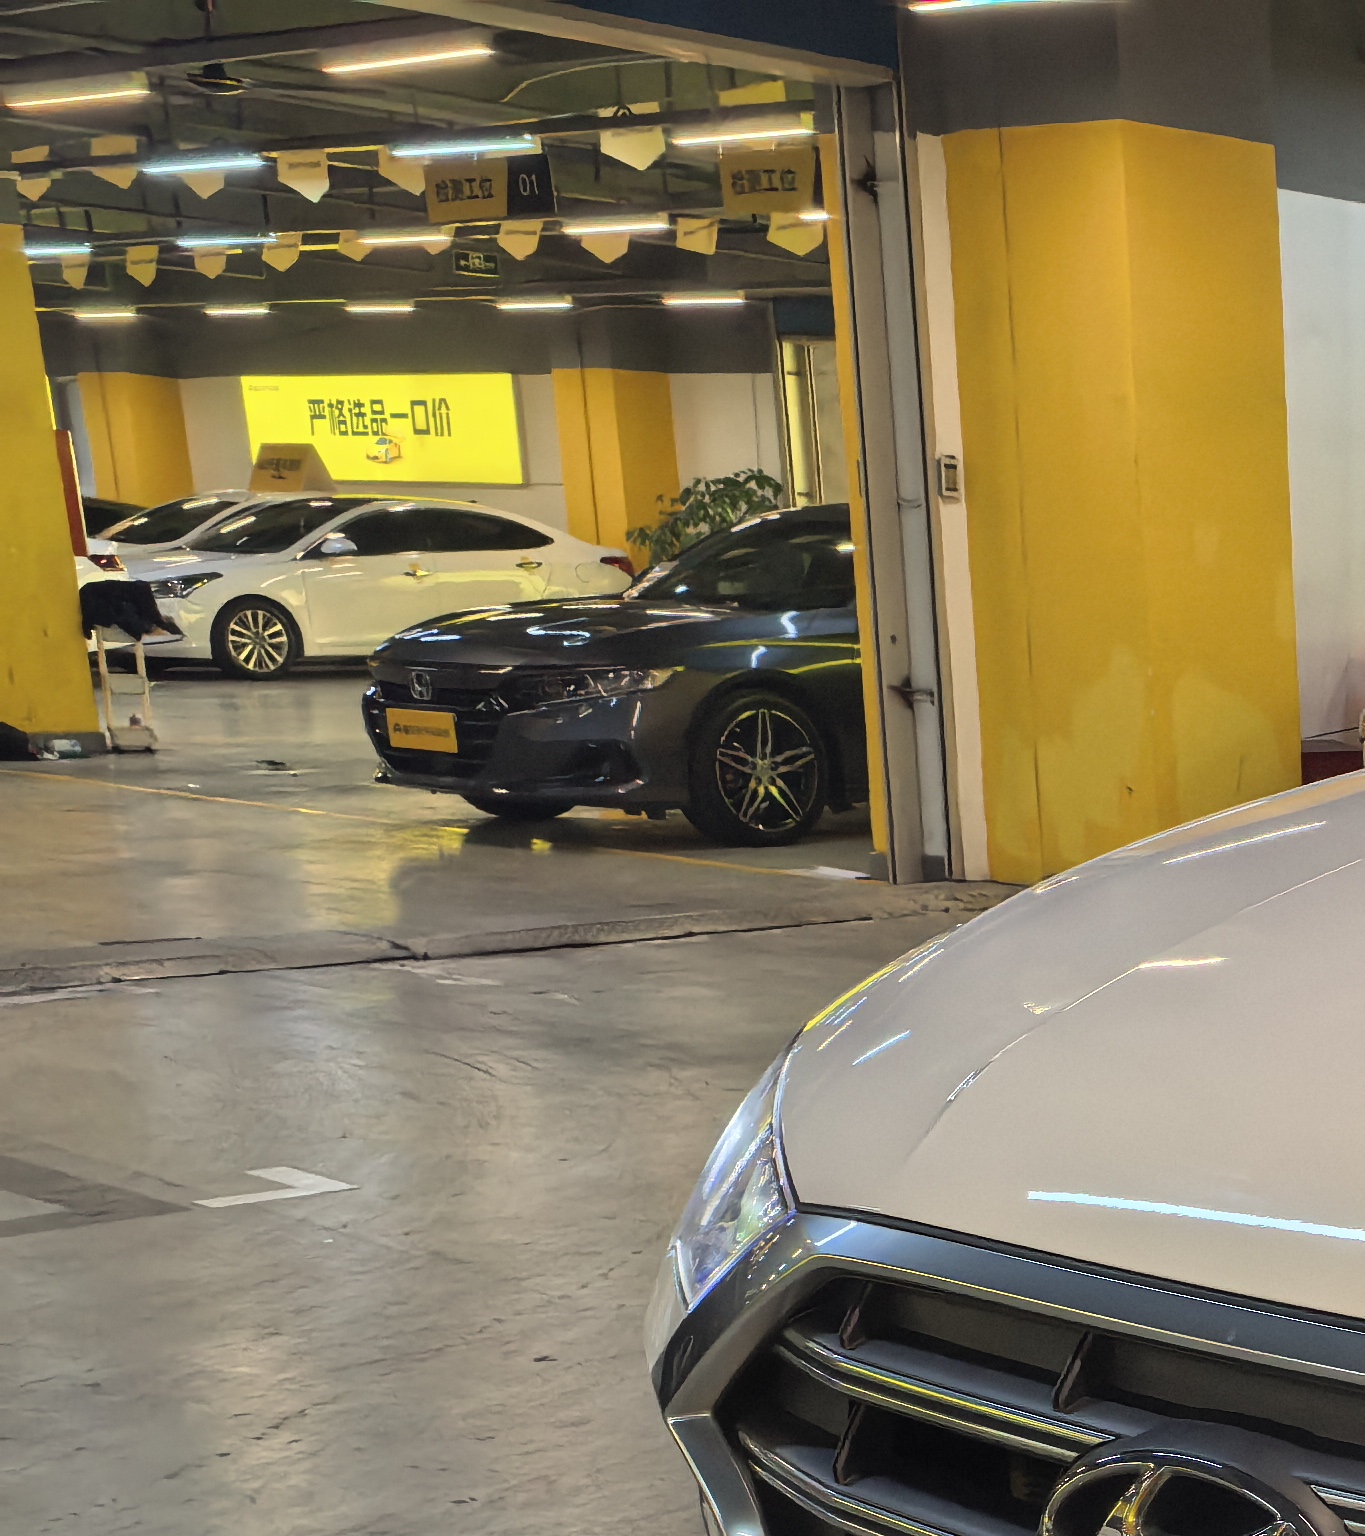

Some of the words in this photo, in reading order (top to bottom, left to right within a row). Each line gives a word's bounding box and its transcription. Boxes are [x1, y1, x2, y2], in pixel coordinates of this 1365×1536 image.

[518, 173, 539, 196] 01
[307, 397, 452, 437] 严格选品一口价
